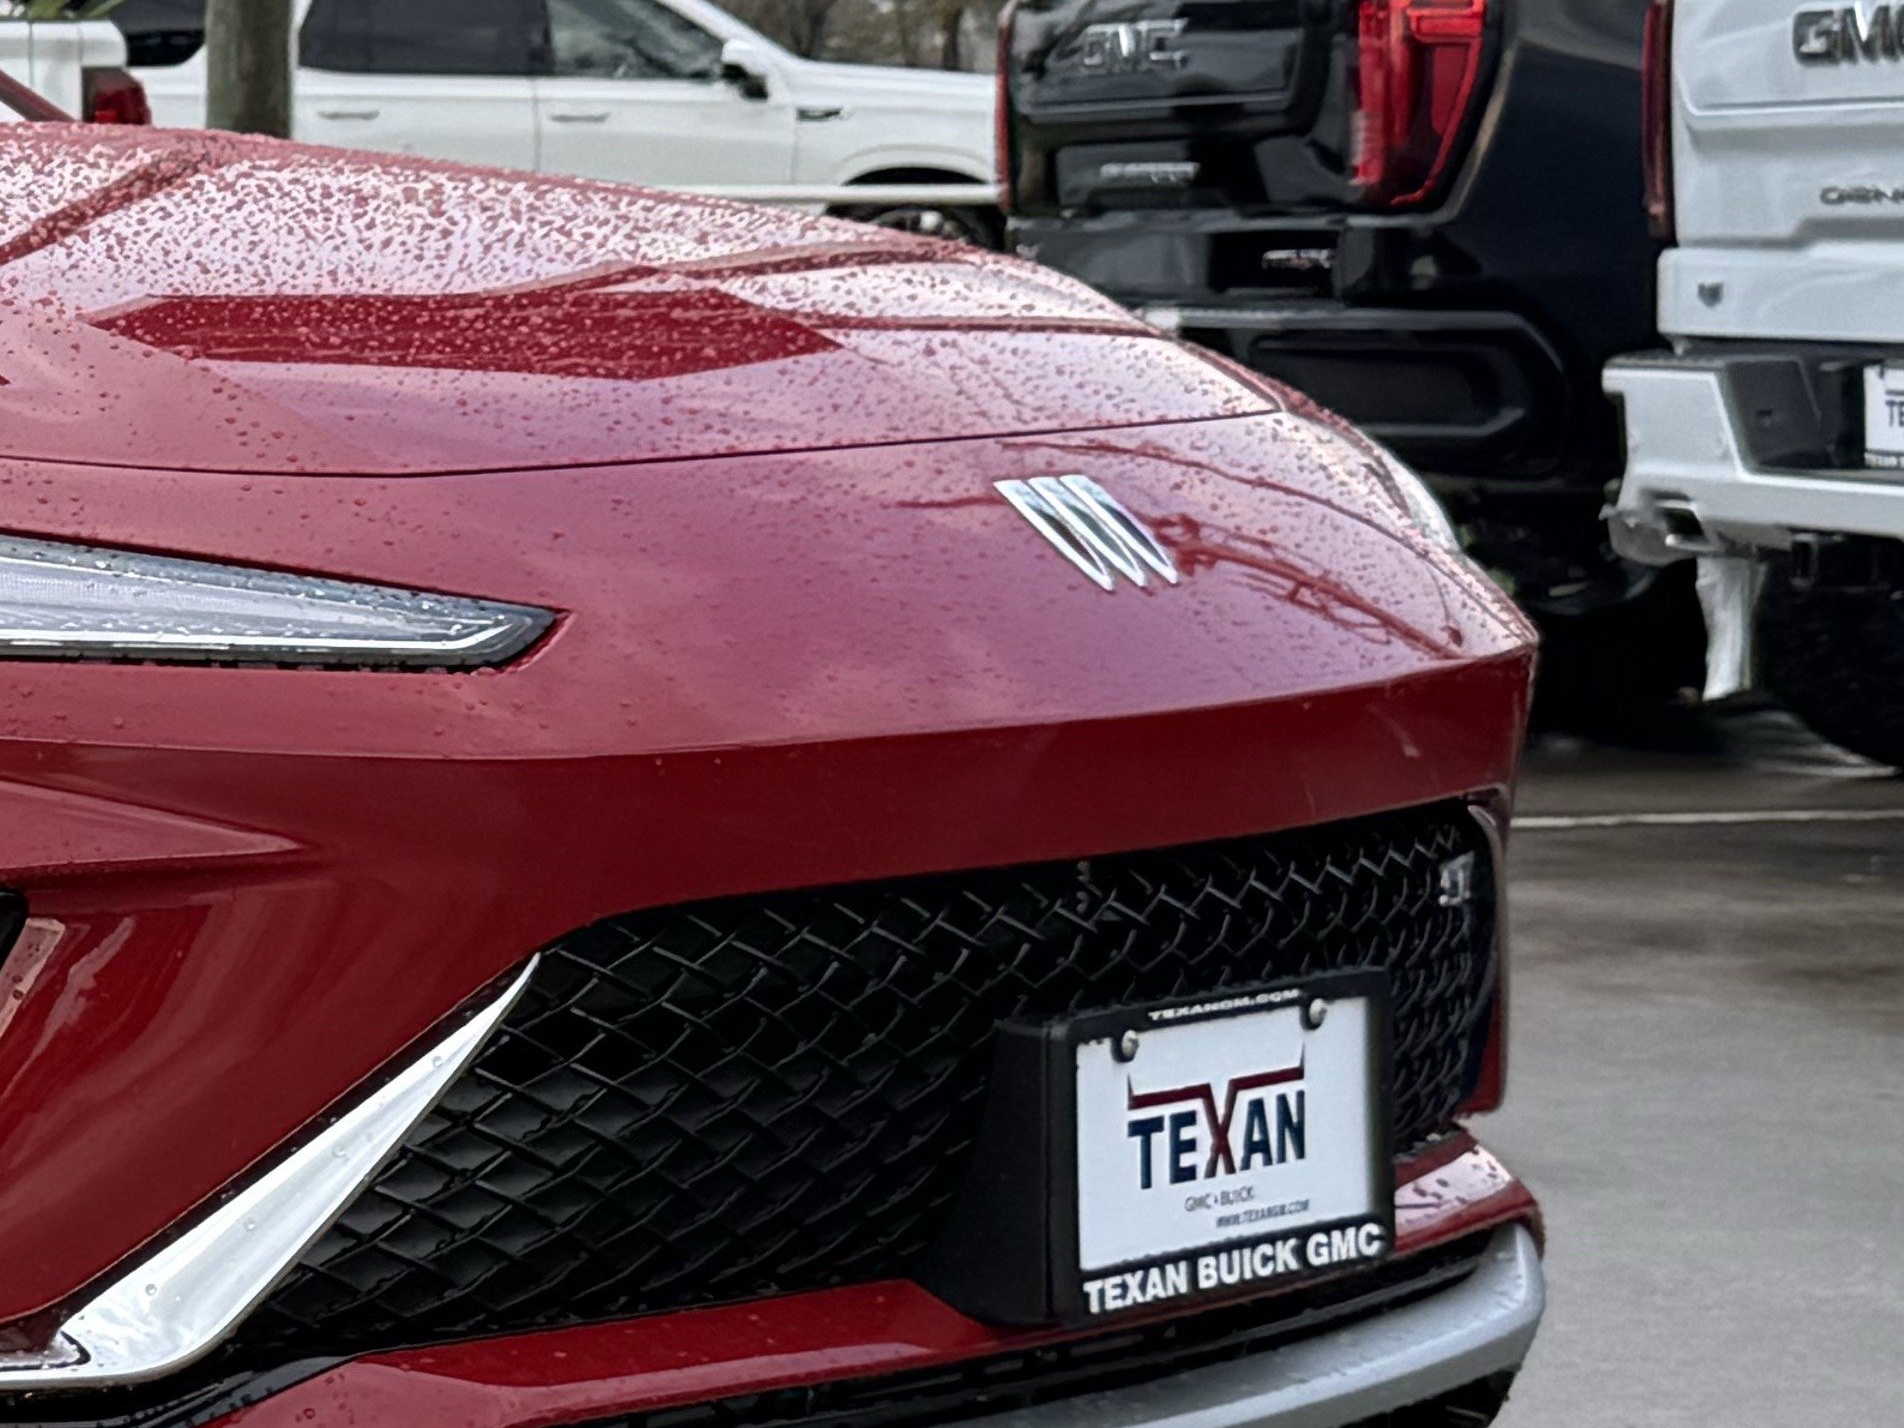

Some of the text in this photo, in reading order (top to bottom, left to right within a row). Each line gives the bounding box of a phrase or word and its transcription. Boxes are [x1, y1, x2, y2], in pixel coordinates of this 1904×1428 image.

[1127, 1065, 1306, 1190] TEXAN
[1083, 1222, 1384, 1315] TEXAN BUICK GMC
